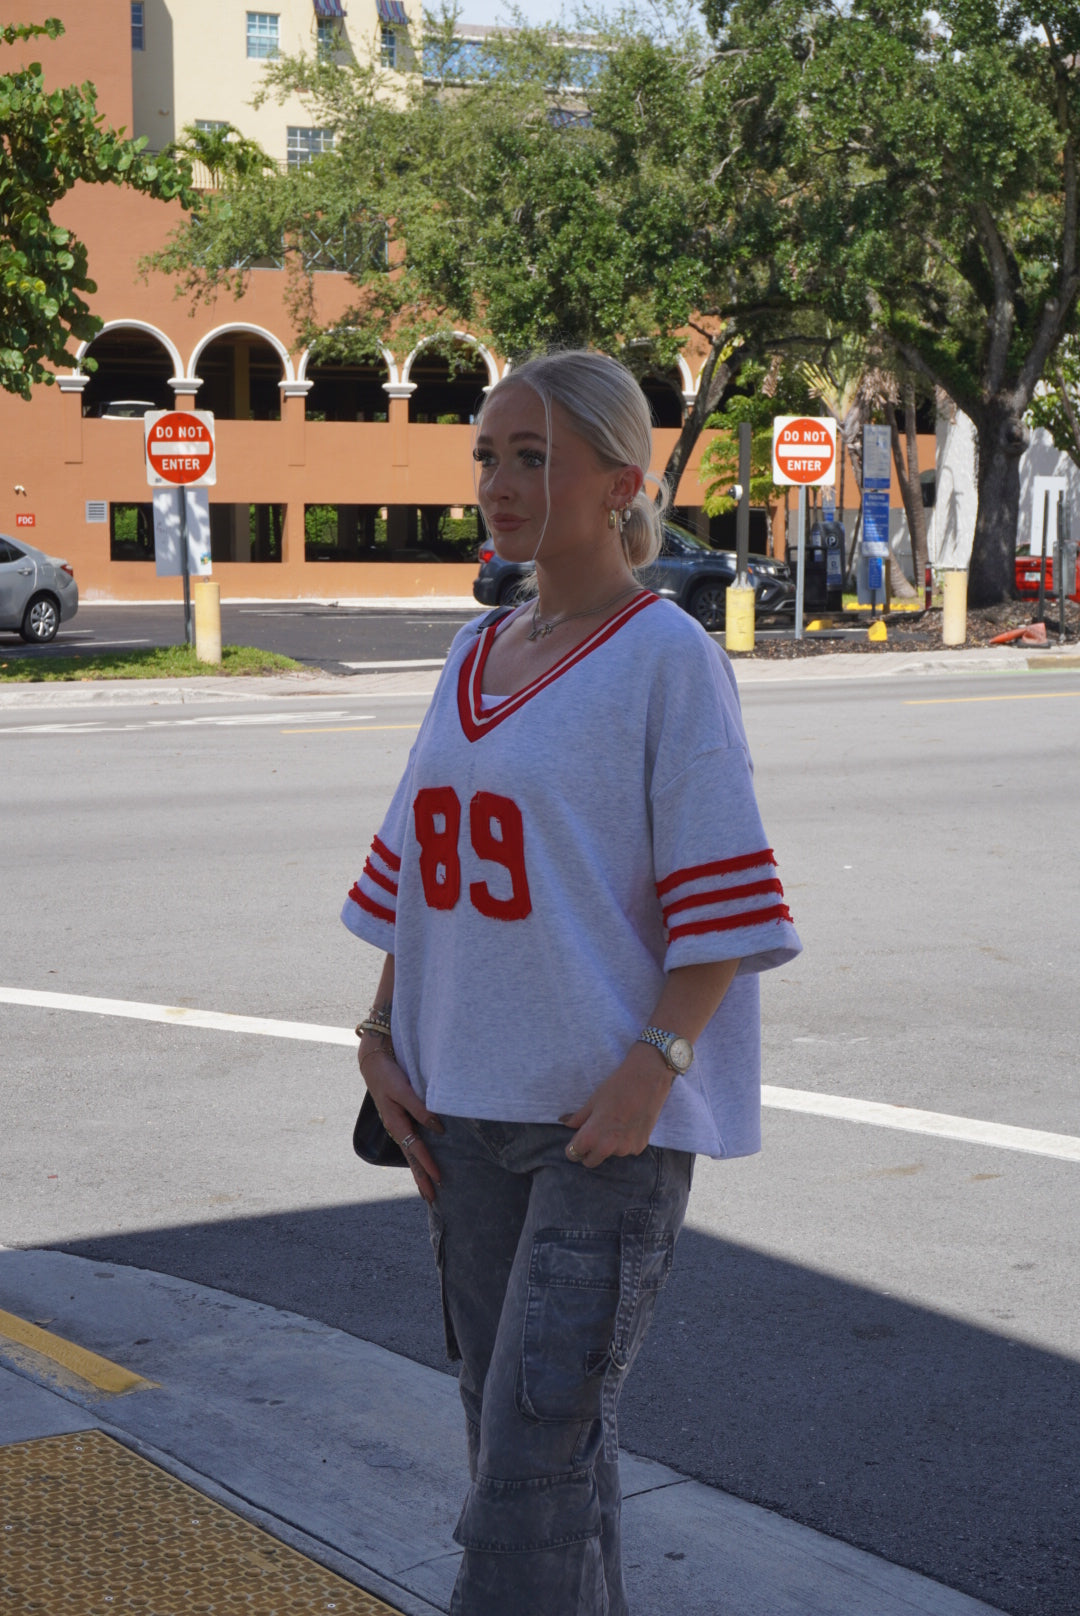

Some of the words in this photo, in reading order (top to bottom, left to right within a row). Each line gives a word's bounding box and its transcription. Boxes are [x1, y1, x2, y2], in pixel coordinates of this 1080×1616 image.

[156, 426, 173, 438] DO
[178, 426, 203, 438] NOT
[784, 431, 800, 442] DO
[803, 431, 827, 442] NOT
[161, 458, 201, 471] ENTER
[787, 460, 822, 471] ENTER
[17, 516, 33, 525] FDC
[413, 786, 532, 922] 89
